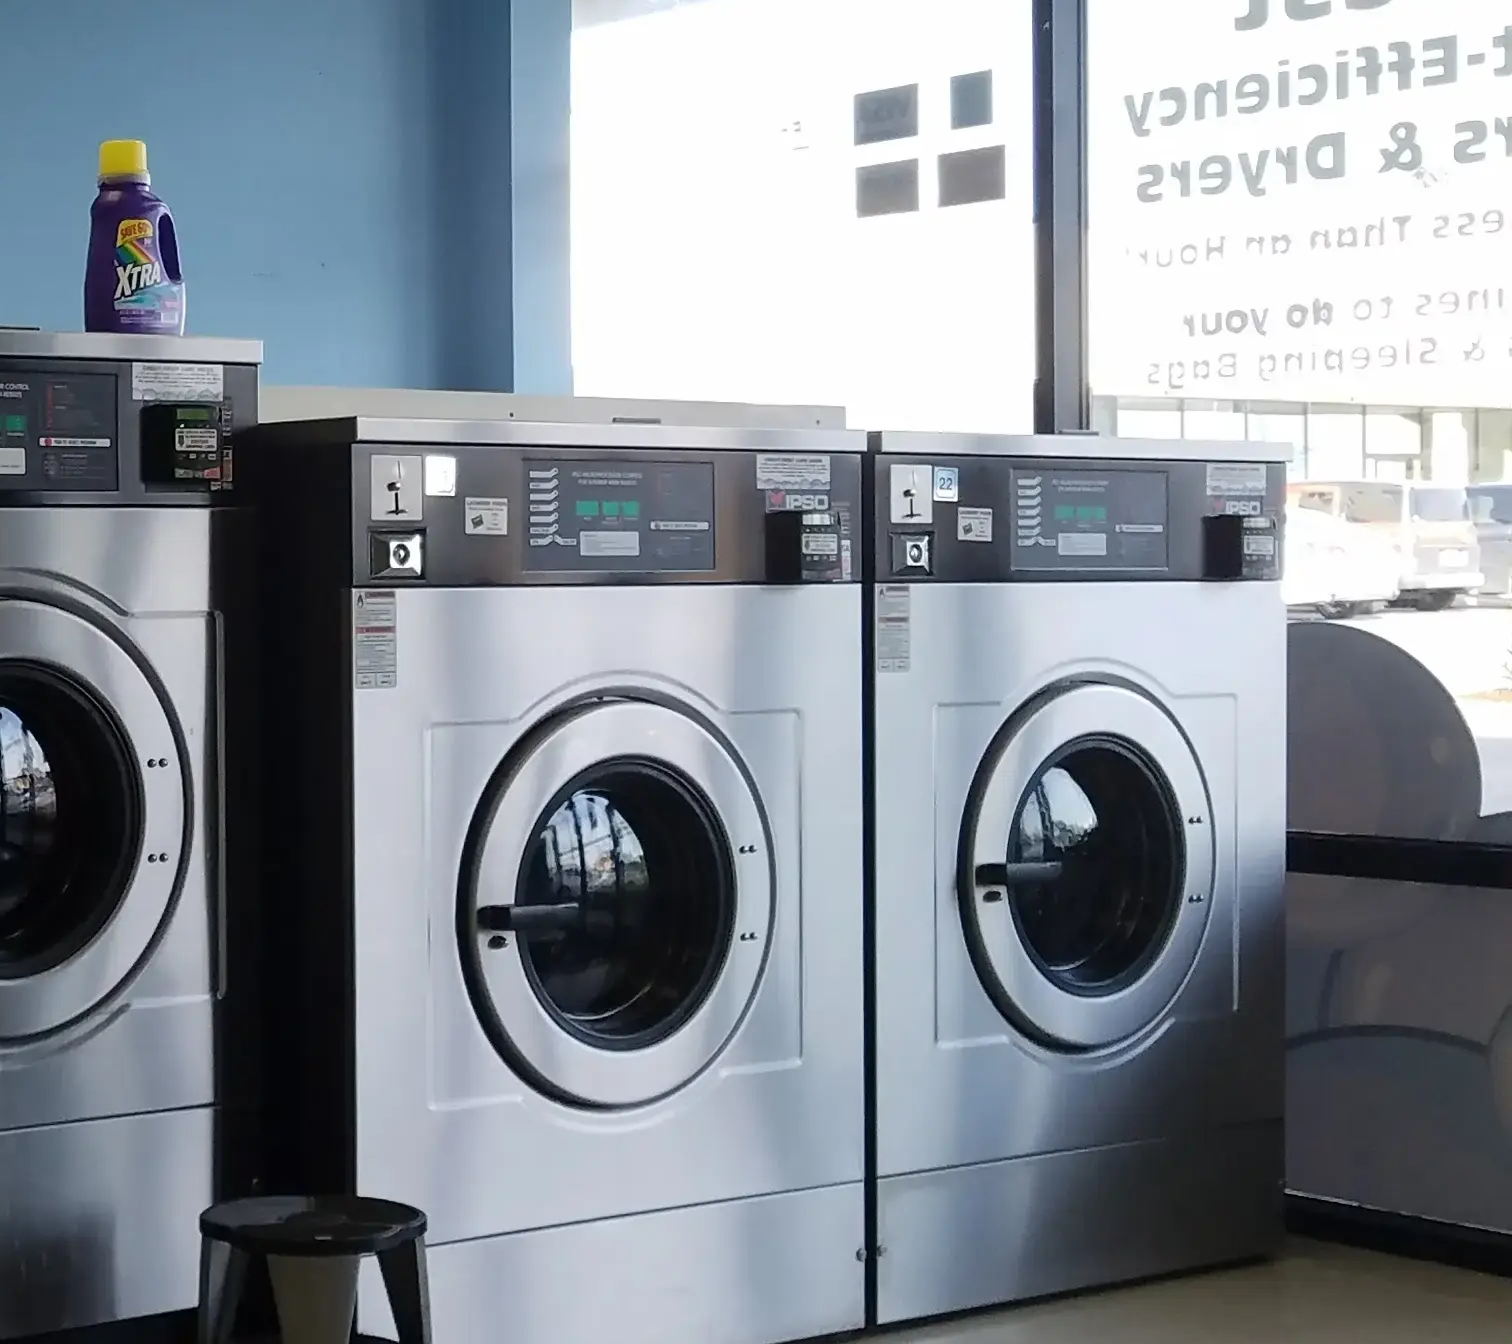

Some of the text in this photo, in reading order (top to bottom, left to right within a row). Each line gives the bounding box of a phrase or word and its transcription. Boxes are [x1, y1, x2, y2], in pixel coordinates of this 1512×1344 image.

[119, 223, 137, 240] SAVE
[113, 260, 161, 300] XTRA
[939, 477, 953, 490] 22
[786, 494, 829, 510] IPSO
[1225, 500, 1261, 515] IPSO
